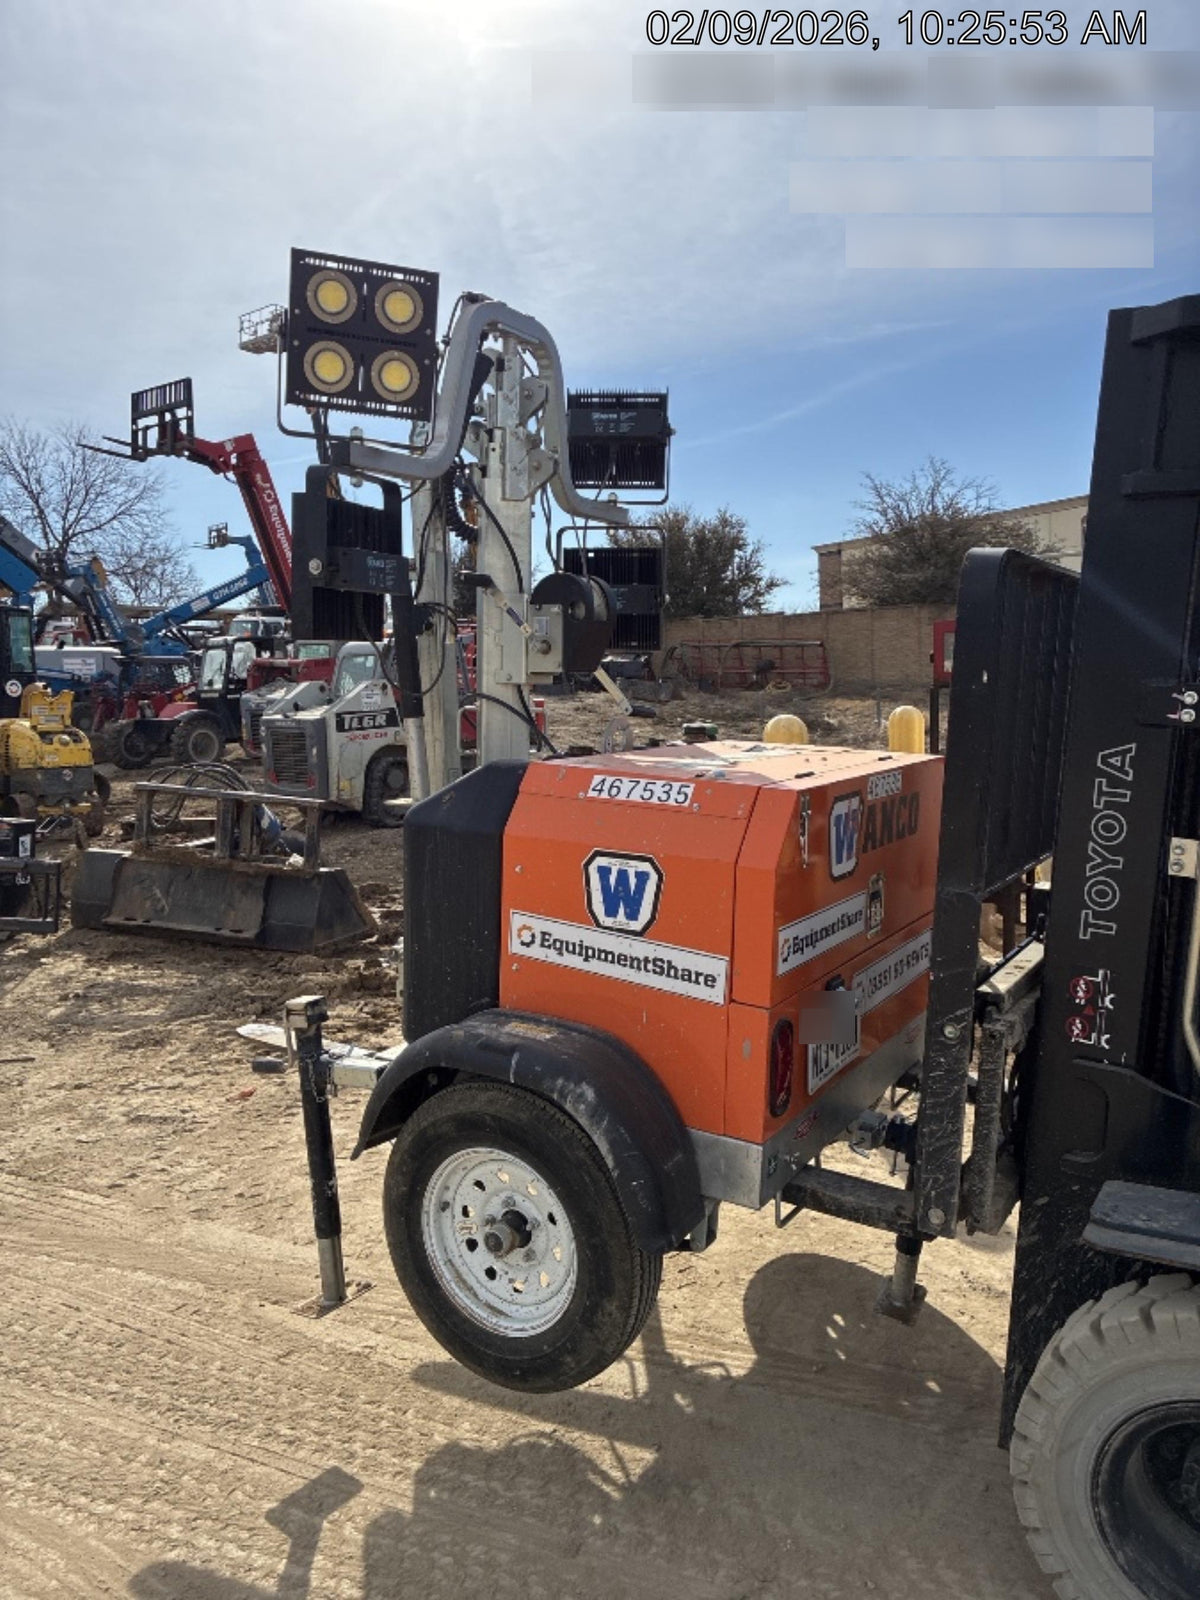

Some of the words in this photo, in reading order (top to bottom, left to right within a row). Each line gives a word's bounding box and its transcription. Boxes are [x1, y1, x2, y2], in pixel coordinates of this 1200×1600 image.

[591, 777, 691, 804] 467535
[1079, 743, 1136, 939] TOYOTA
[597, 866, 650, 921] W
[540, 931, 717, 988] EquipmentShare
